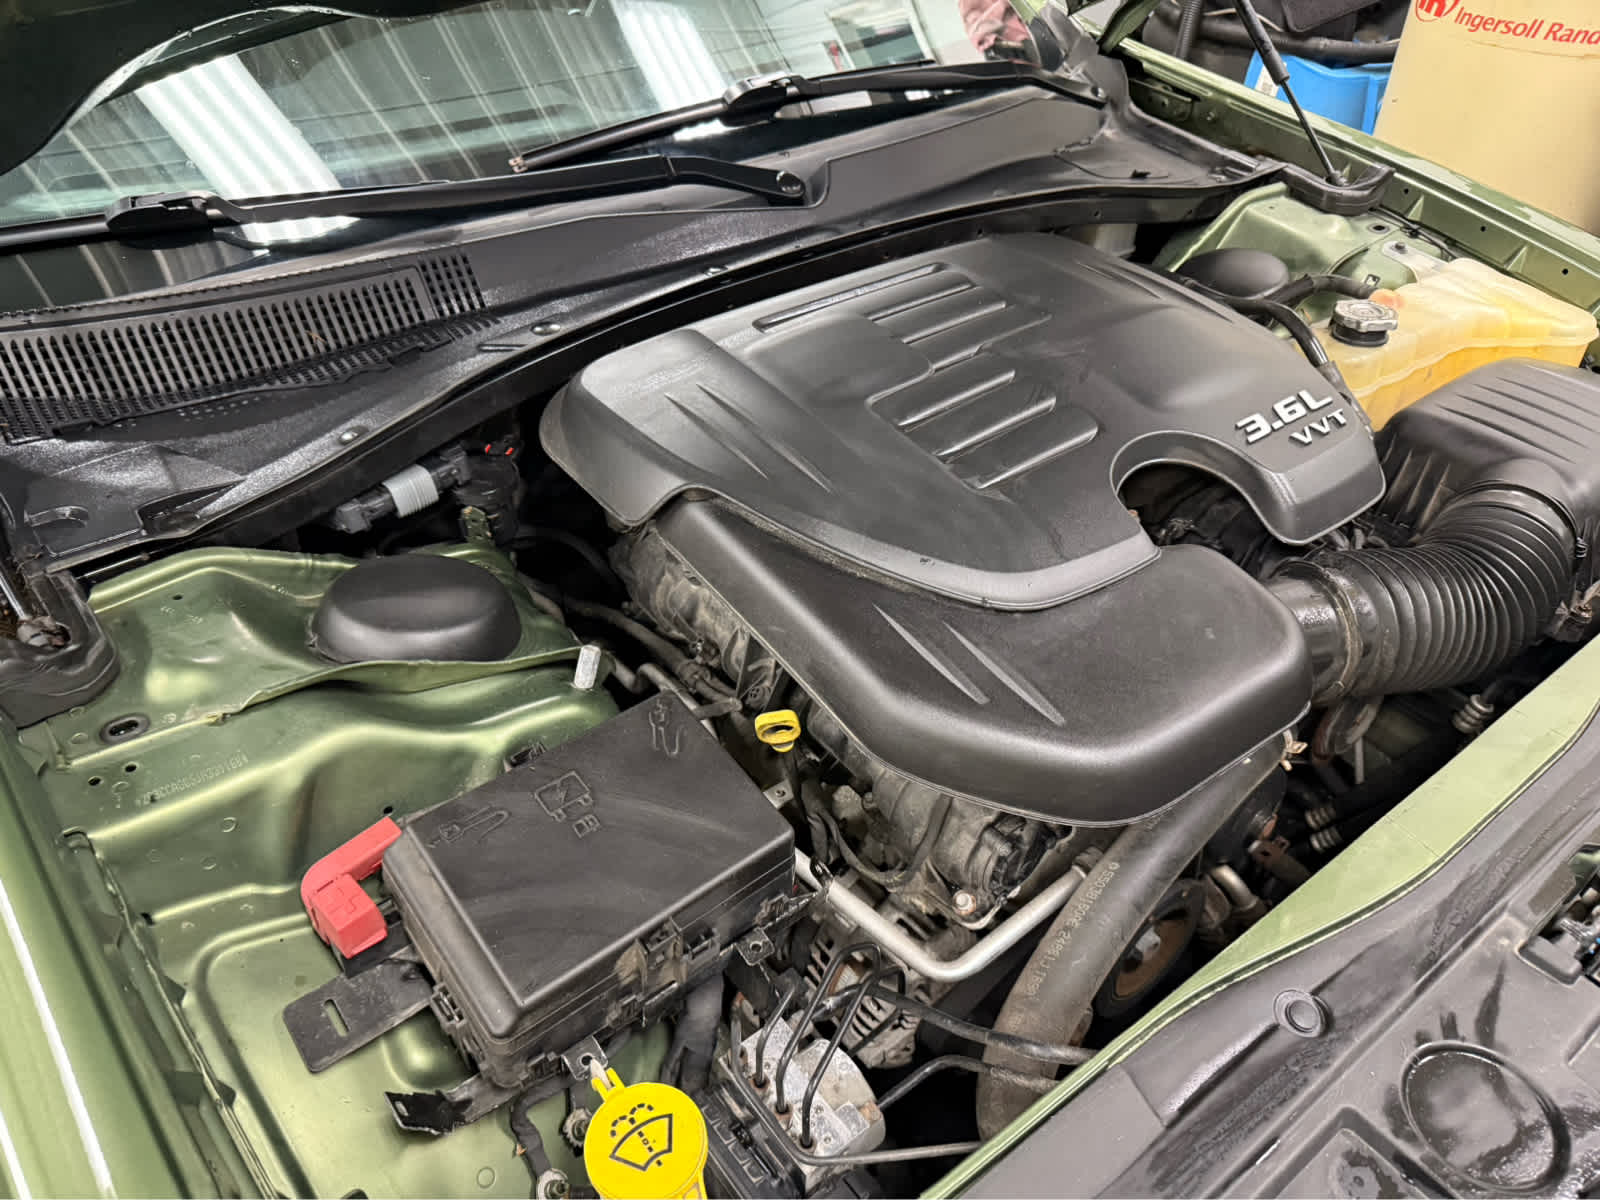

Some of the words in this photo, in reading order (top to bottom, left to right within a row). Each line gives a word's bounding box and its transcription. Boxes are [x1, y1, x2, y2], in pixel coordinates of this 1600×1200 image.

[1453, 6, 1544, 39] Ingersoll
[1236, 389, 1333, 444] 3.6L
[1290, 408, 1347, 444] VVT
